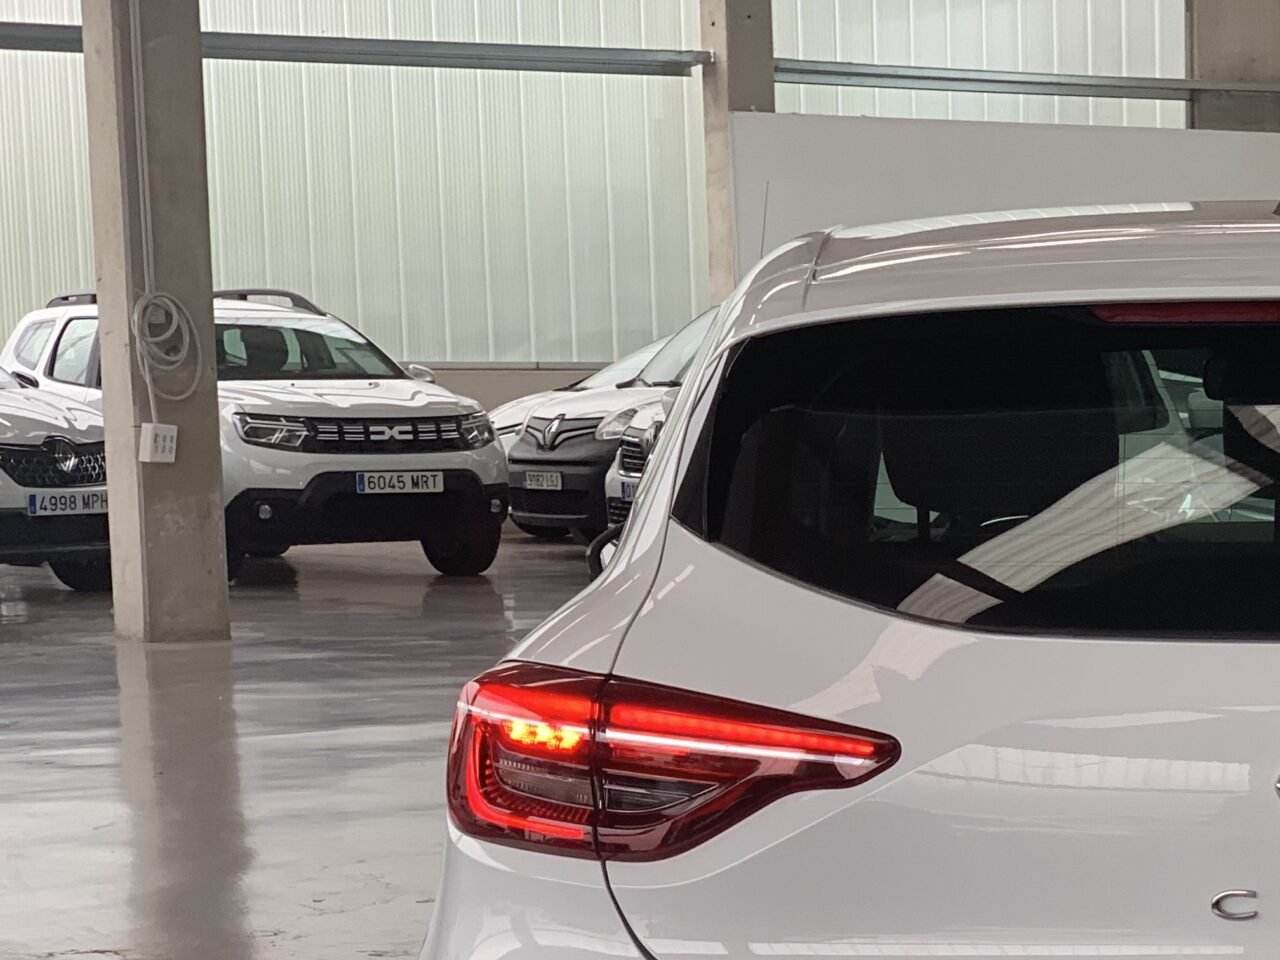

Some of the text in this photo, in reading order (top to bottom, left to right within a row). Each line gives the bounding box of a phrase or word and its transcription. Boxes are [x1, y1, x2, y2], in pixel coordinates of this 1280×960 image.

[367, 474, 439, 490] 6045 MRT
[39, 493, 108, 511] 4998 MPH
